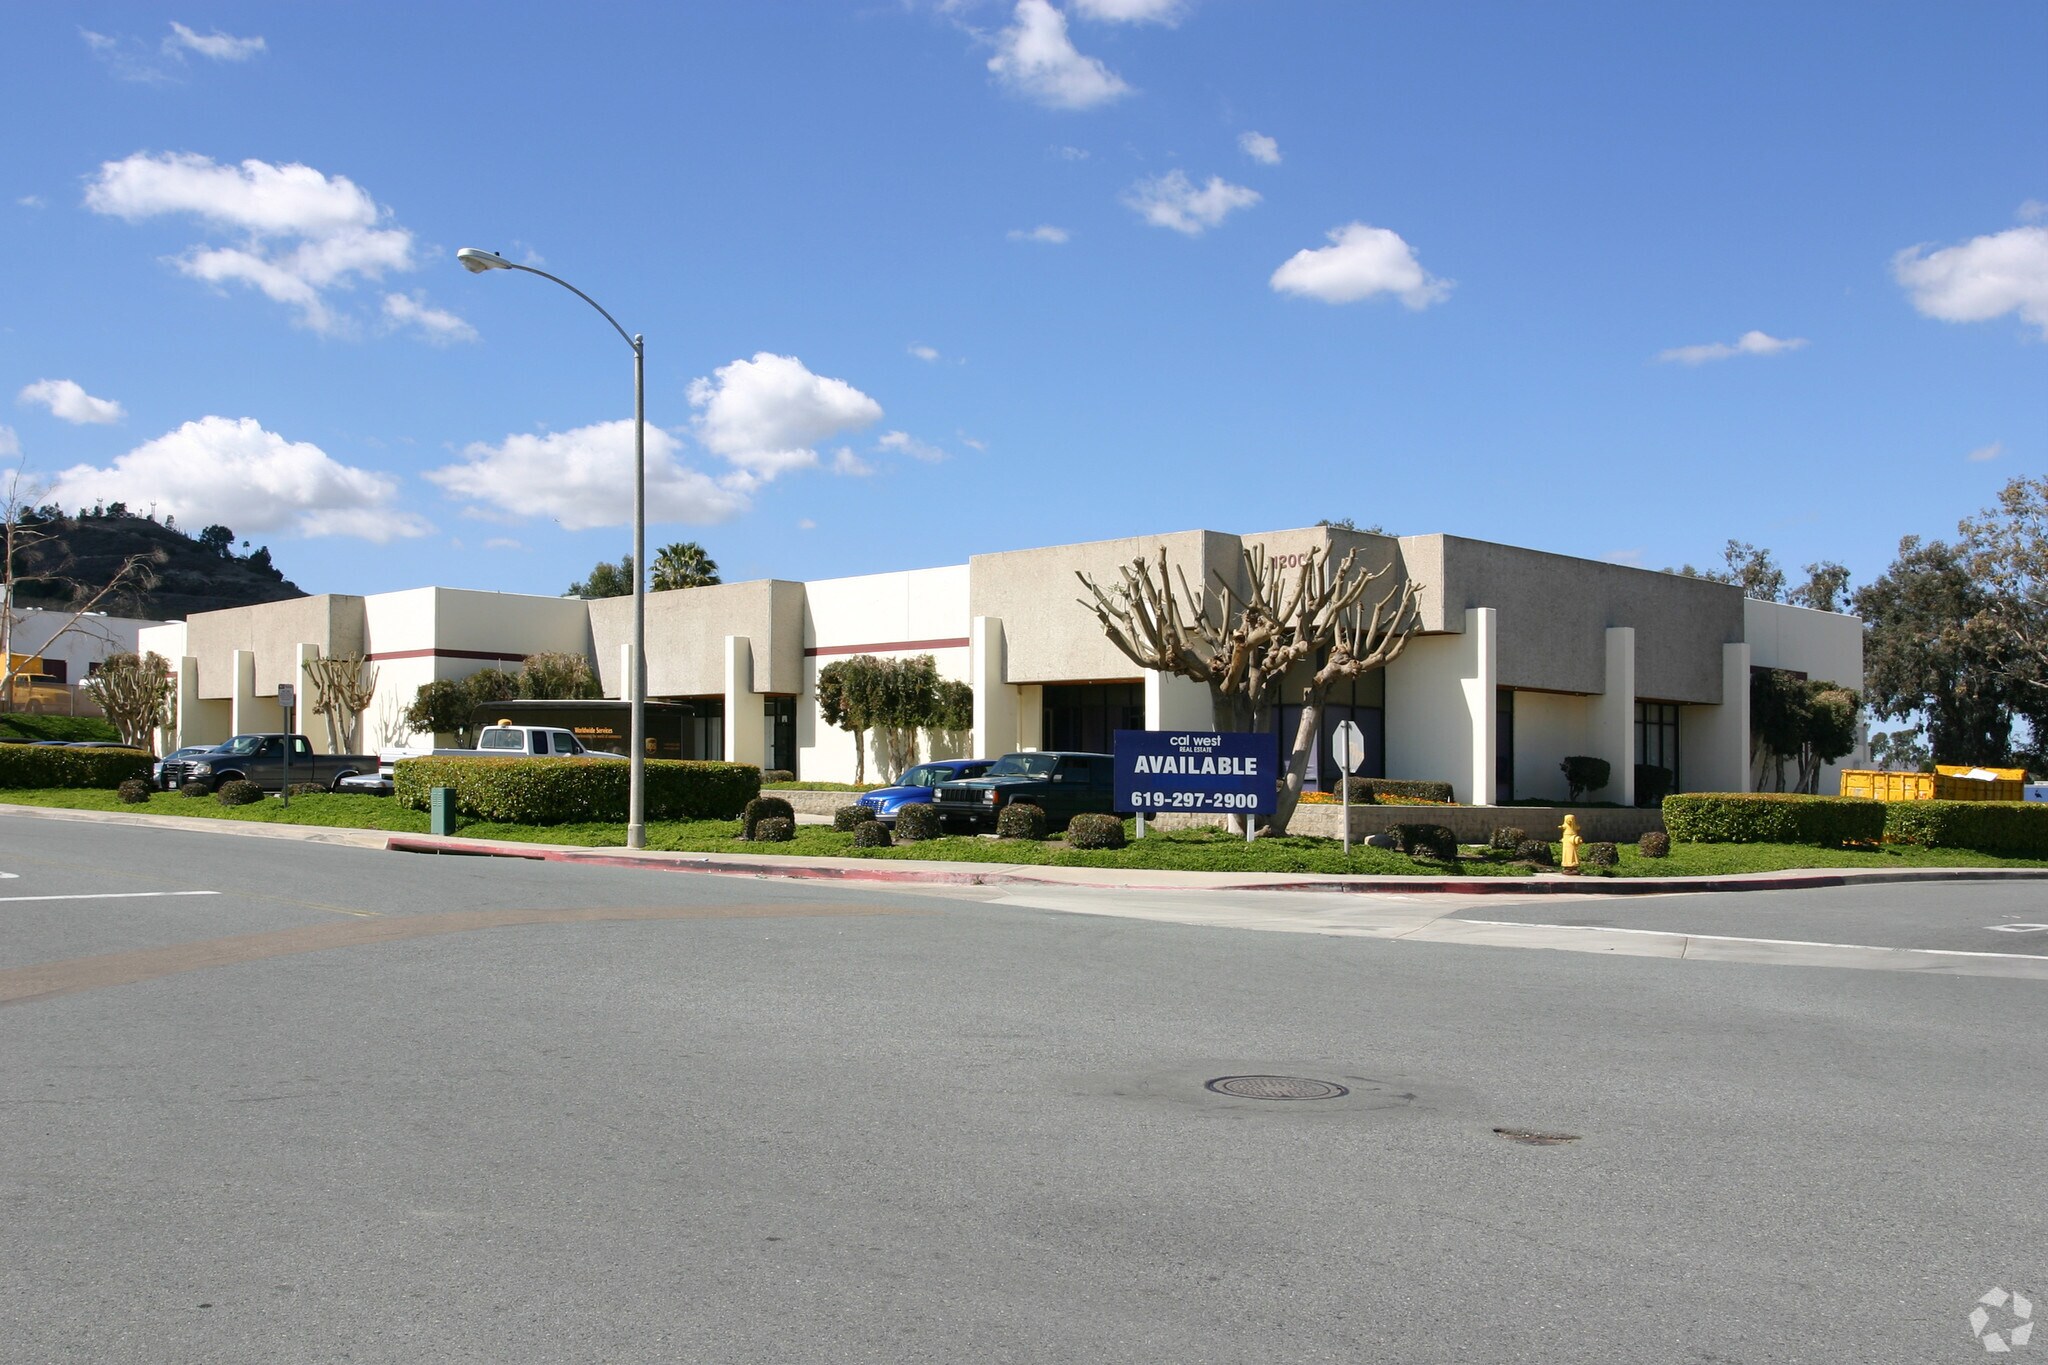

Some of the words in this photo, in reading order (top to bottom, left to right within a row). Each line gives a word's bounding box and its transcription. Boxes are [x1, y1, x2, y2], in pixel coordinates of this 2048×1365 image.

[596, 726, 613, 734] Services
[1170, 735, 1189, 746] cal
[1193, 735, 1221, 746] west
[1134, 755, 1257, 775] AVAILABLE
[1131, 791, 1258, 809] 619-297-2900
